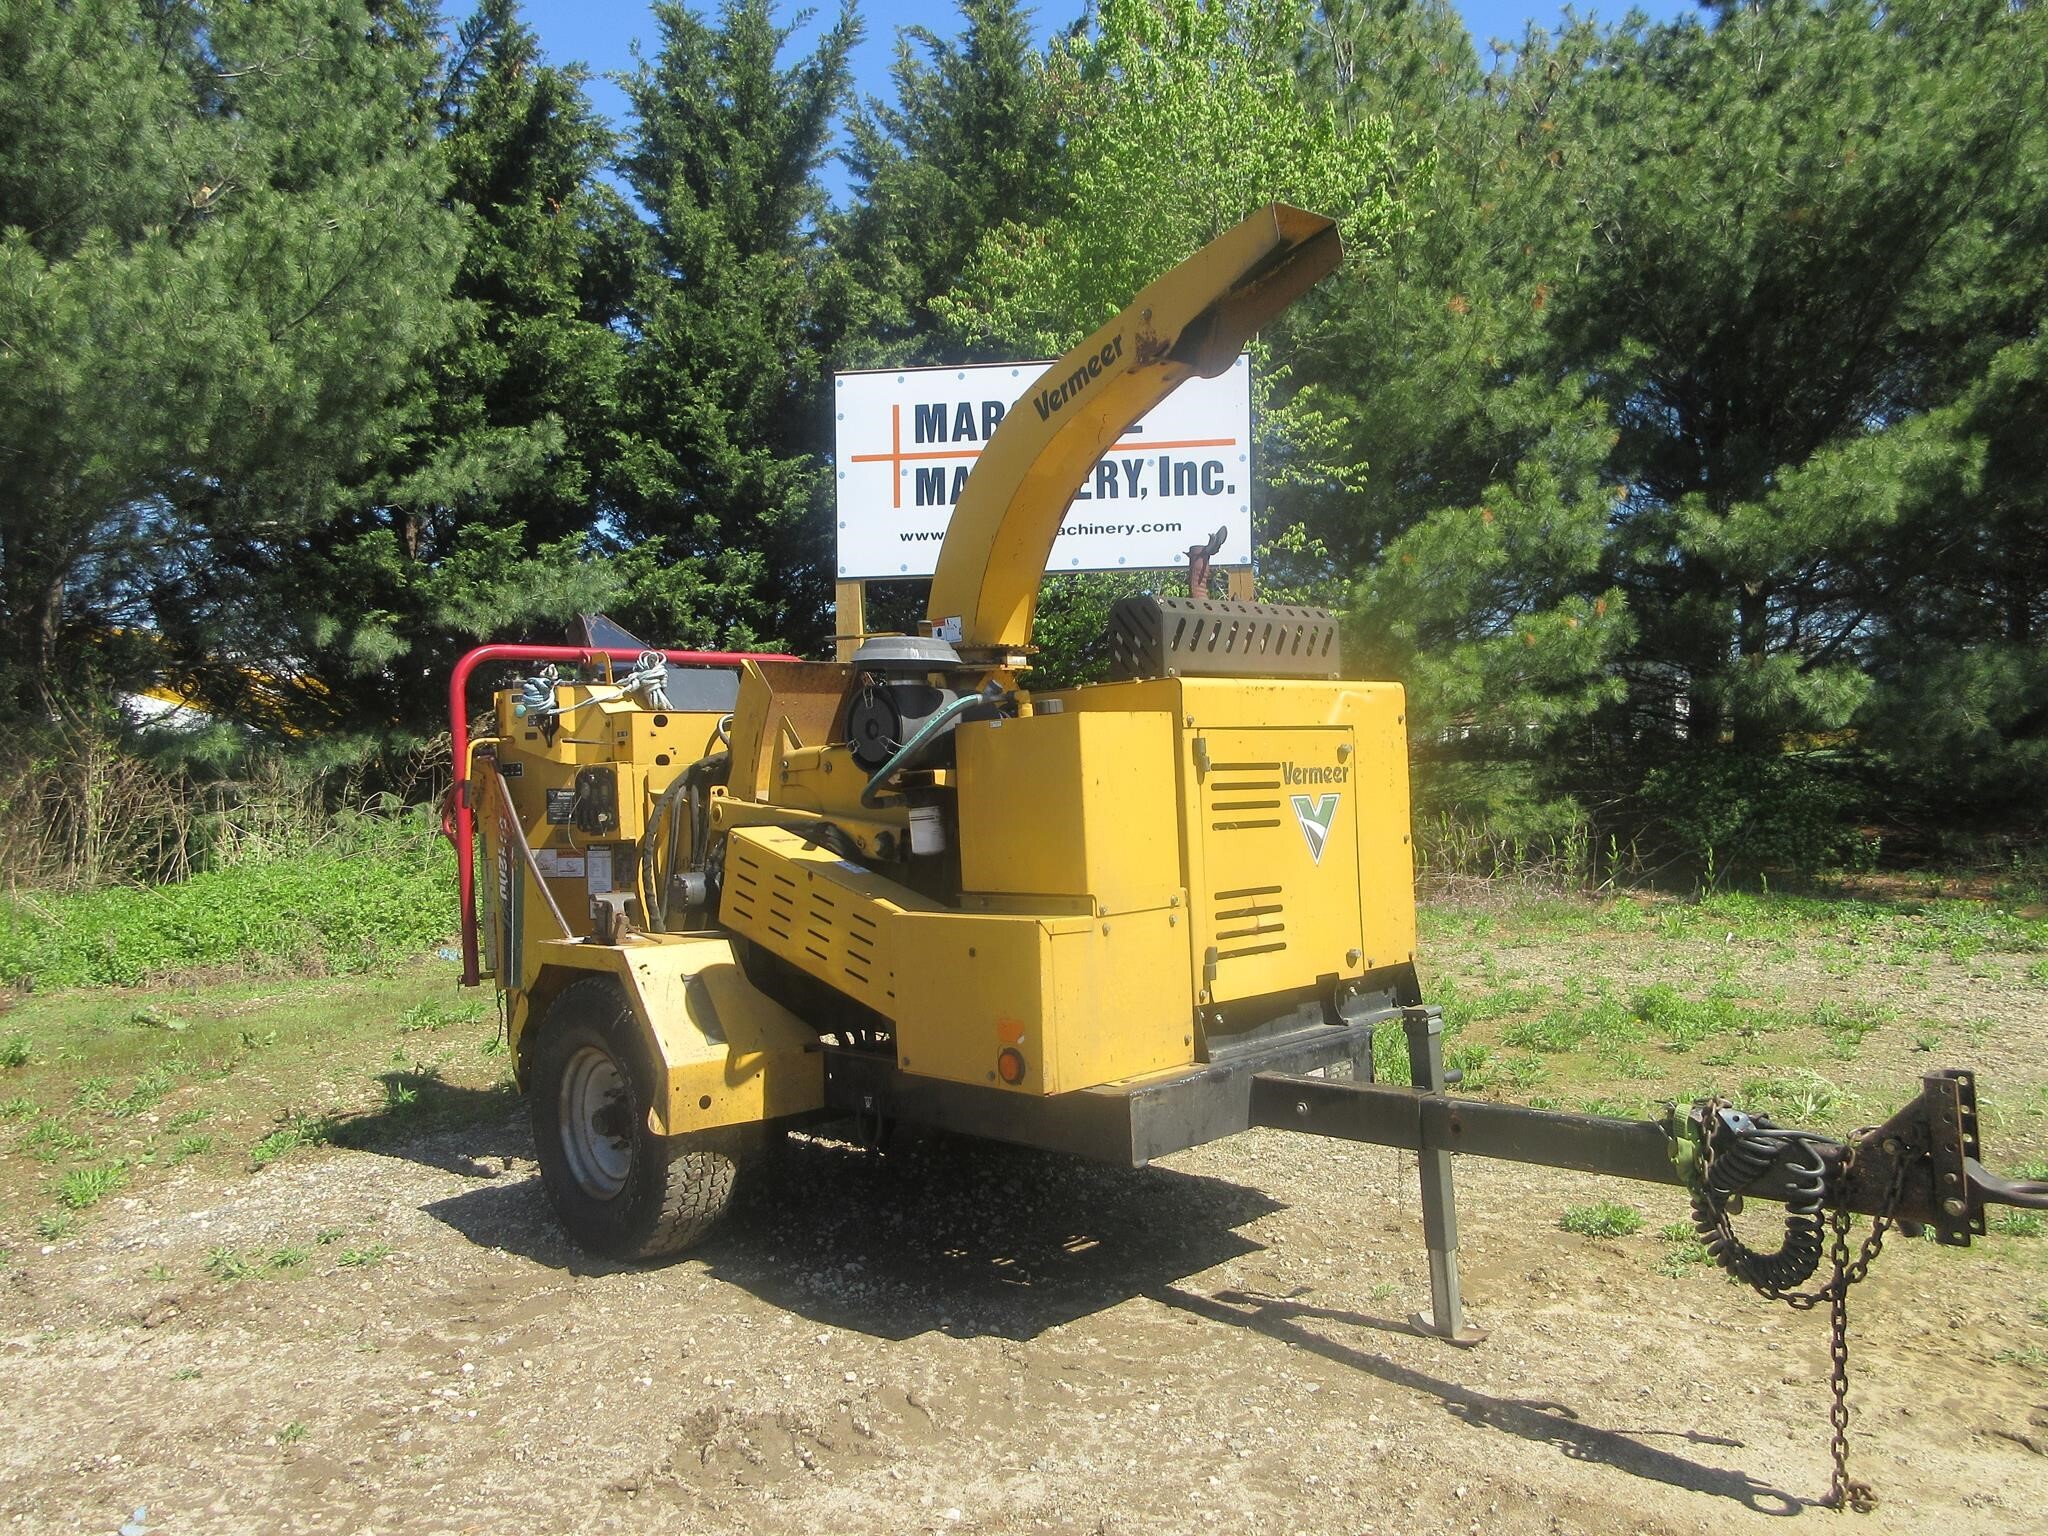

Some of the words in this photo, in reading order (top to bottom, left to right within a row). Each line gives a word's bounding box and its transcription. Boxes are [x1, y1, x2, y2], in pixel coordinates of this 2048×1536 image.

[1033, 334, 1122, 421] Vermeer
[1159, 456, 1235, 497] Inc.
[1282, 761, 1348, 785] Vermeer
